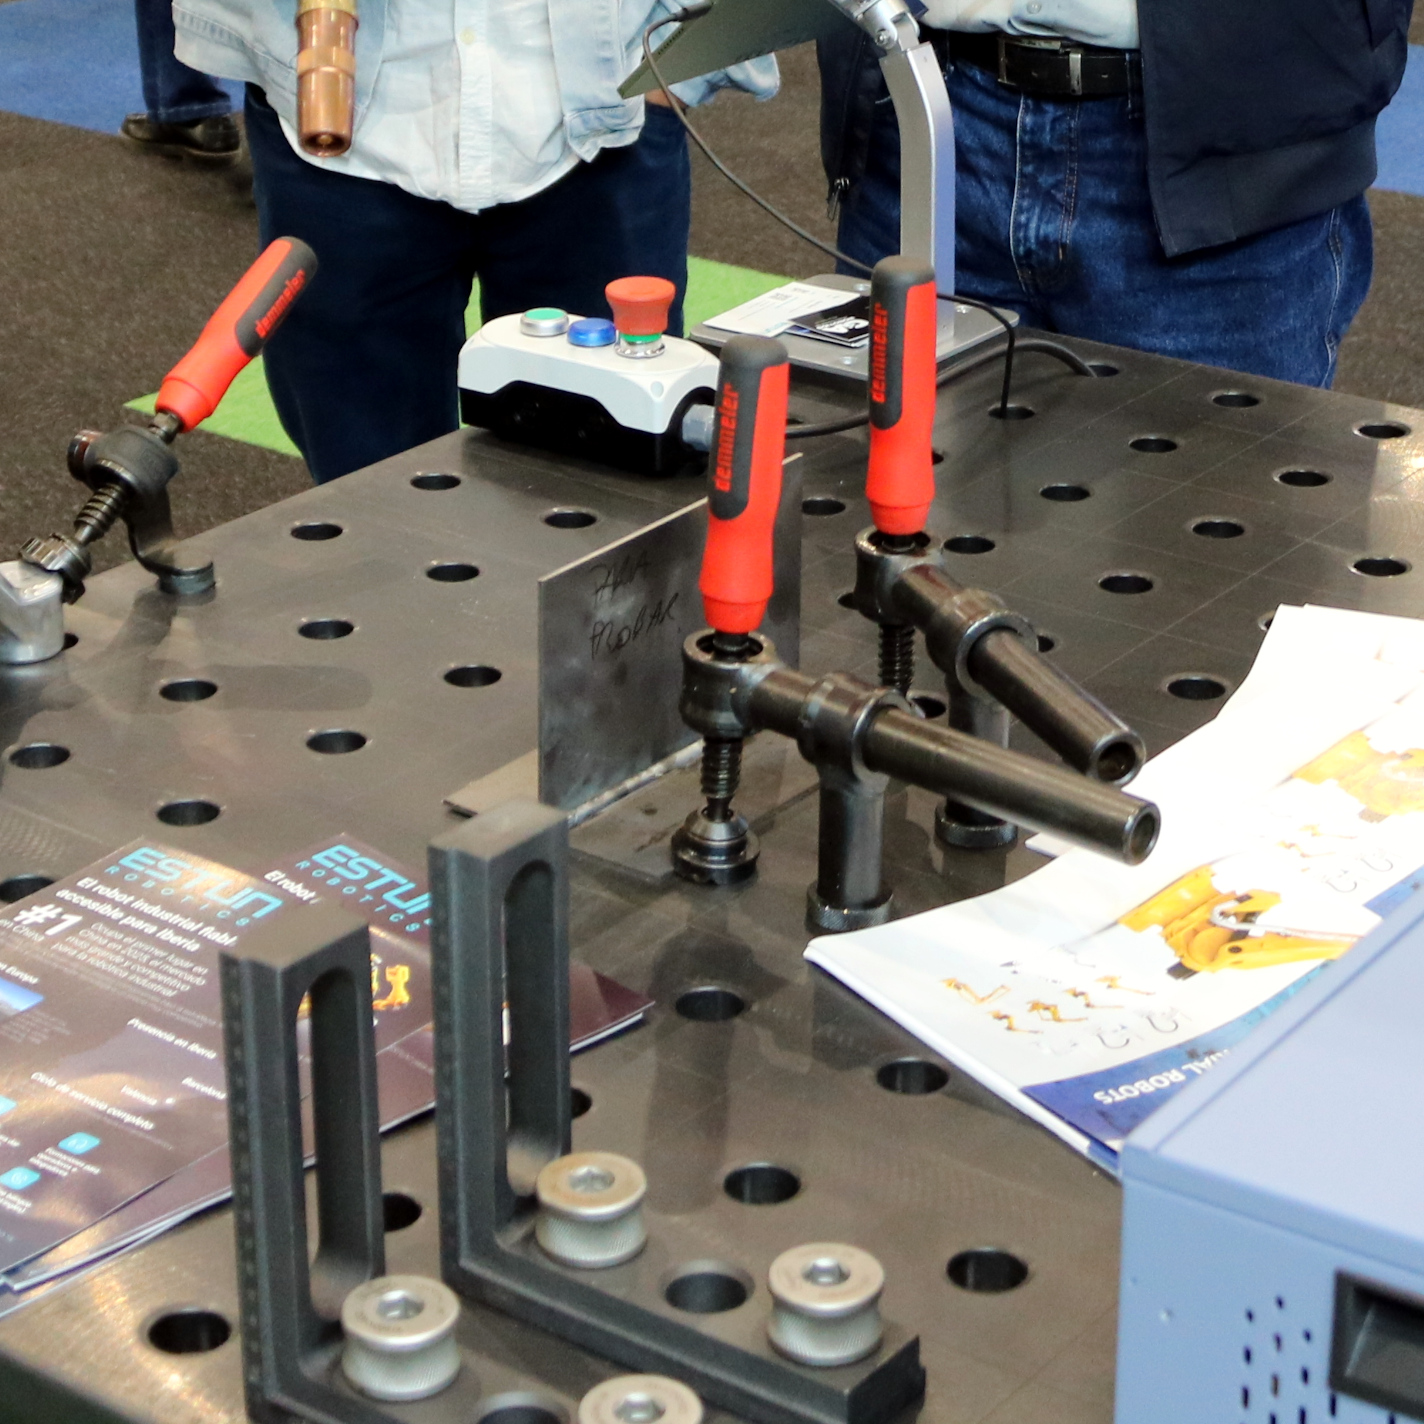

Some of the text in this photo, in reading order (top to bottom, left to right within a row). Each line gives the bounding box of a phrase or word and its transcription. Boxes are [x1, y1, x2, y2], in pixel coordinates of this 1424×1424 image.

[117, 845, 284, 919] ESTUN
[276, 880, 318, 902] robot
[11, 900, 82, 934] #1
[54, 886, 204, 951] accesible para Iberia
[90, 882, 137, 904] robot
[129, 898, 203, 932] industrial
[197, 925, 242, 947] fiabl
[1093, 1067, 1187, 1105] ROBOTS
